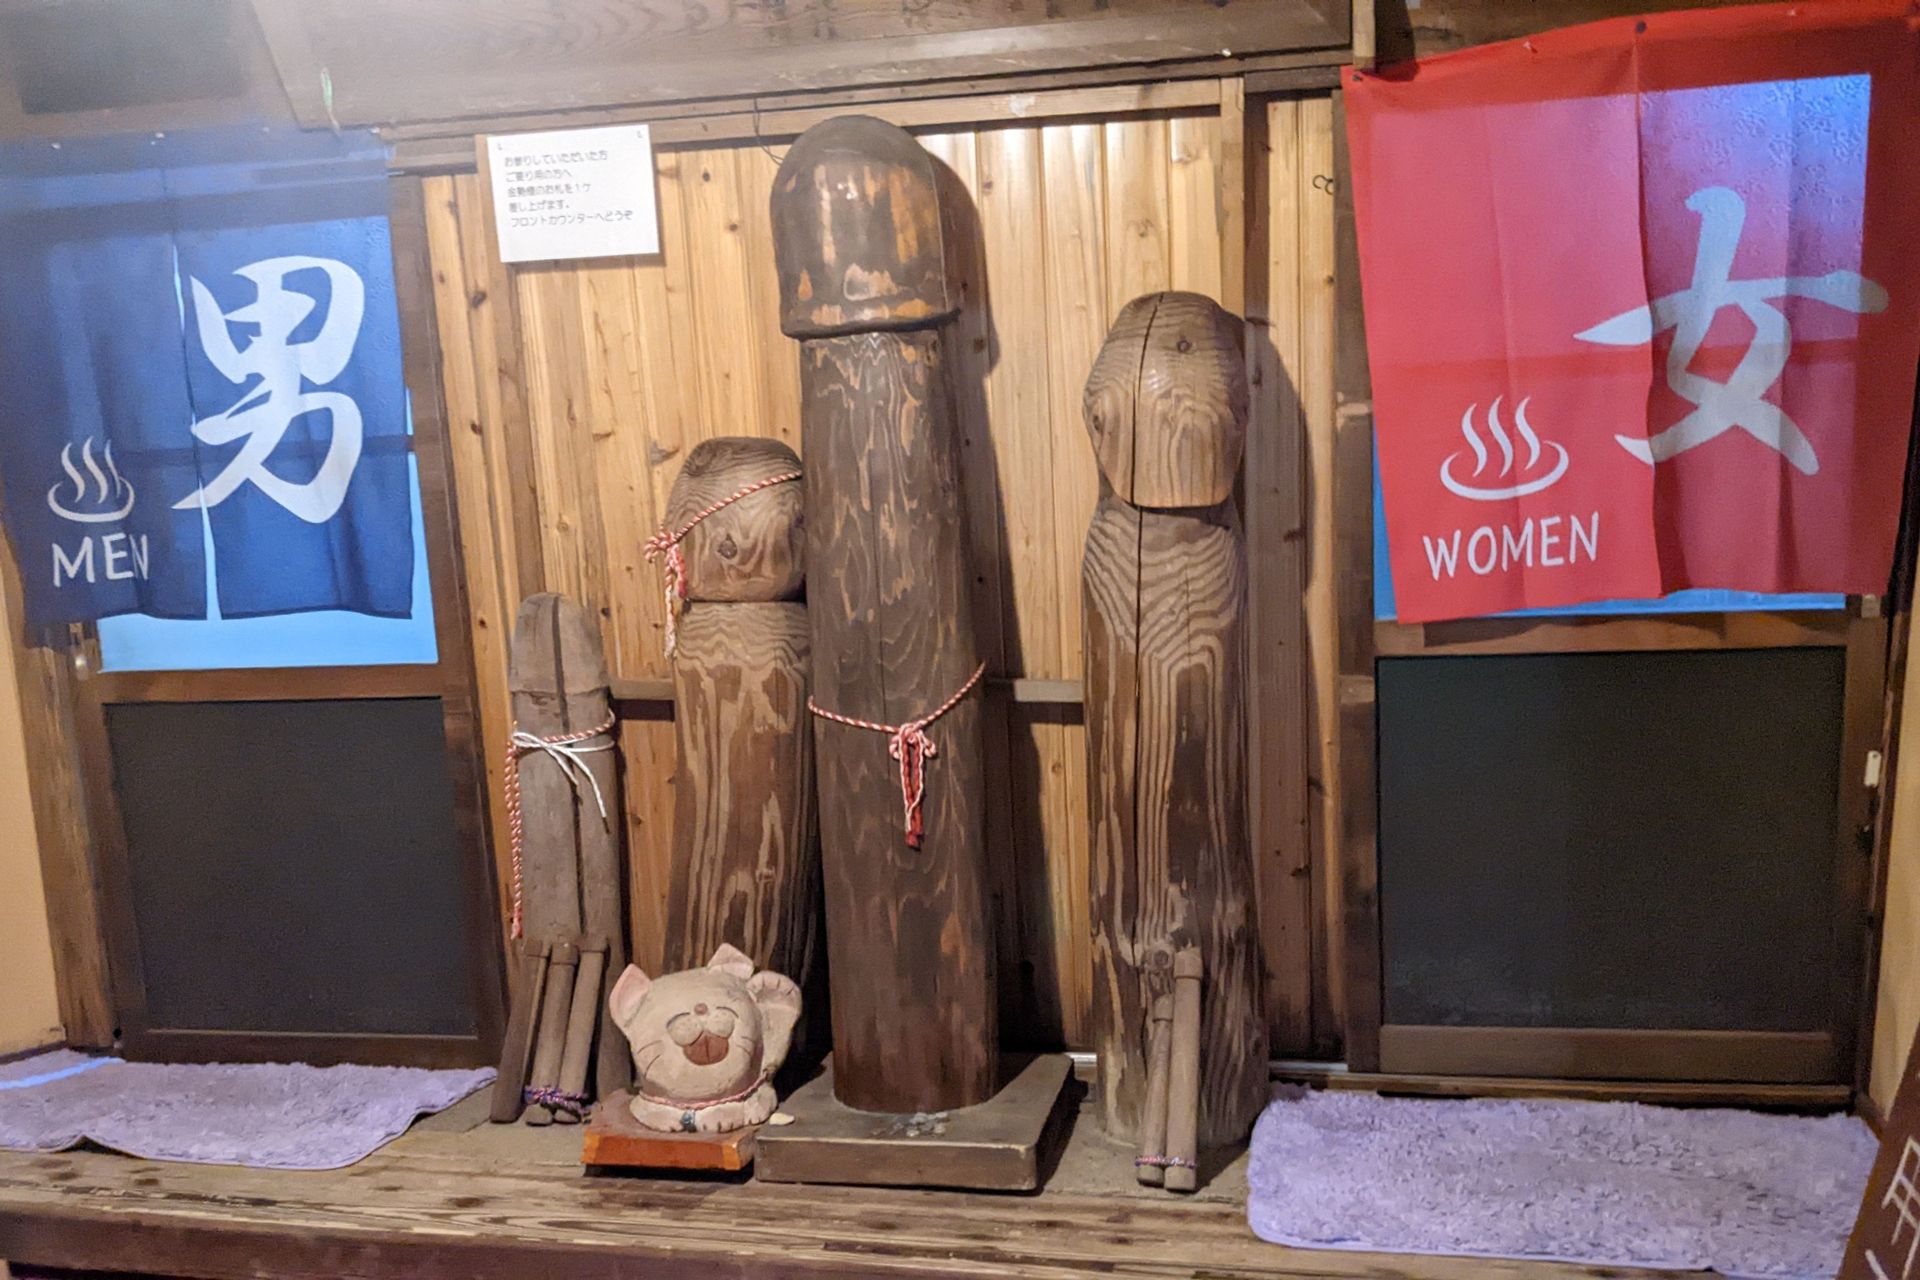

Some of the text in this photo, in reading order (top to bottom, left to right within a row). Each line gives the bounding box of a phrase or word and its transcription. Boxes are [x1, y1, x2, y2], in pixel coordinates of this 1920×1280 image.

[511, 210, 633, 228] フロントカウンターへどうぞ
[1572, 186, 1890, 477] 女
[171, 255, 365, 524] 男
[51, 532, 149, 587] MEN
[1422, 510, 1600, 582] WOMEN
